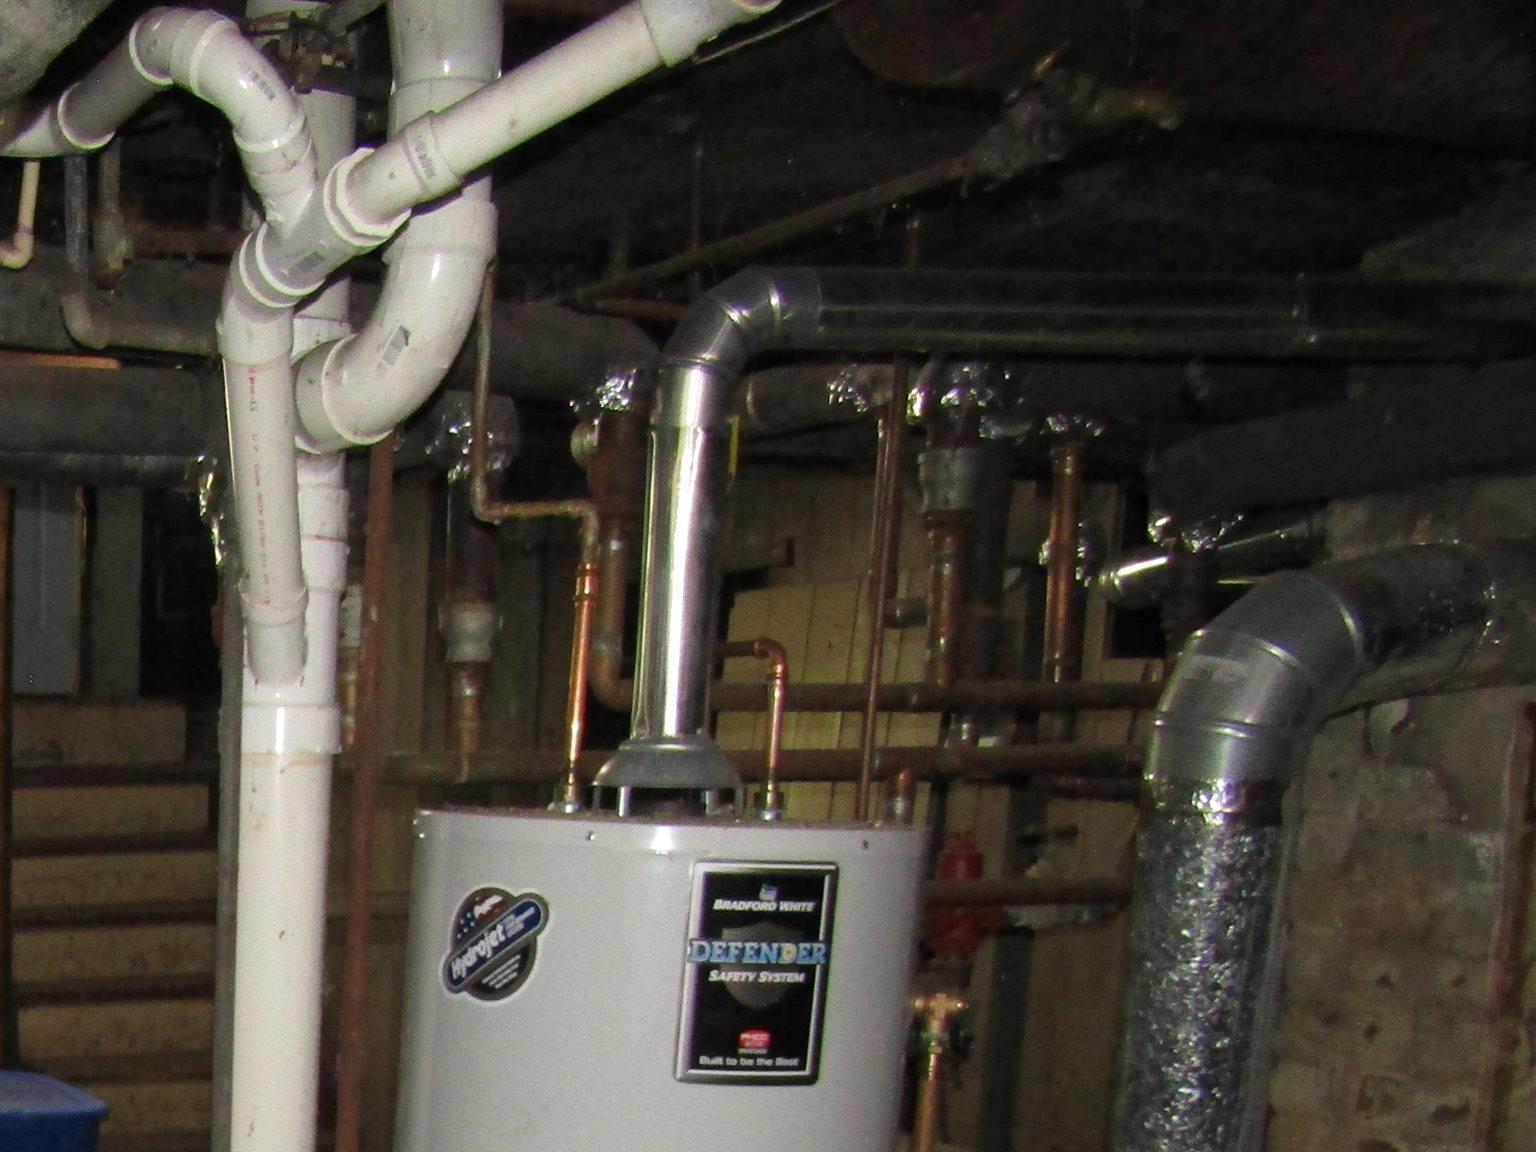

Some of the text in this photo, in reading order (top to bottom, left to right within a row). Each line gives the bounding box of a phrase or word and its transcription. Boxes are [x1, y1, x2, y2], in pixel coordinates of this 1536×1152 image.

[713, 899, 815, 913] BRADFORD WHITE
[689, 940, 826, 965] DEFENDER
[709, 970, 805, 983] SAFETY SYSTEM
